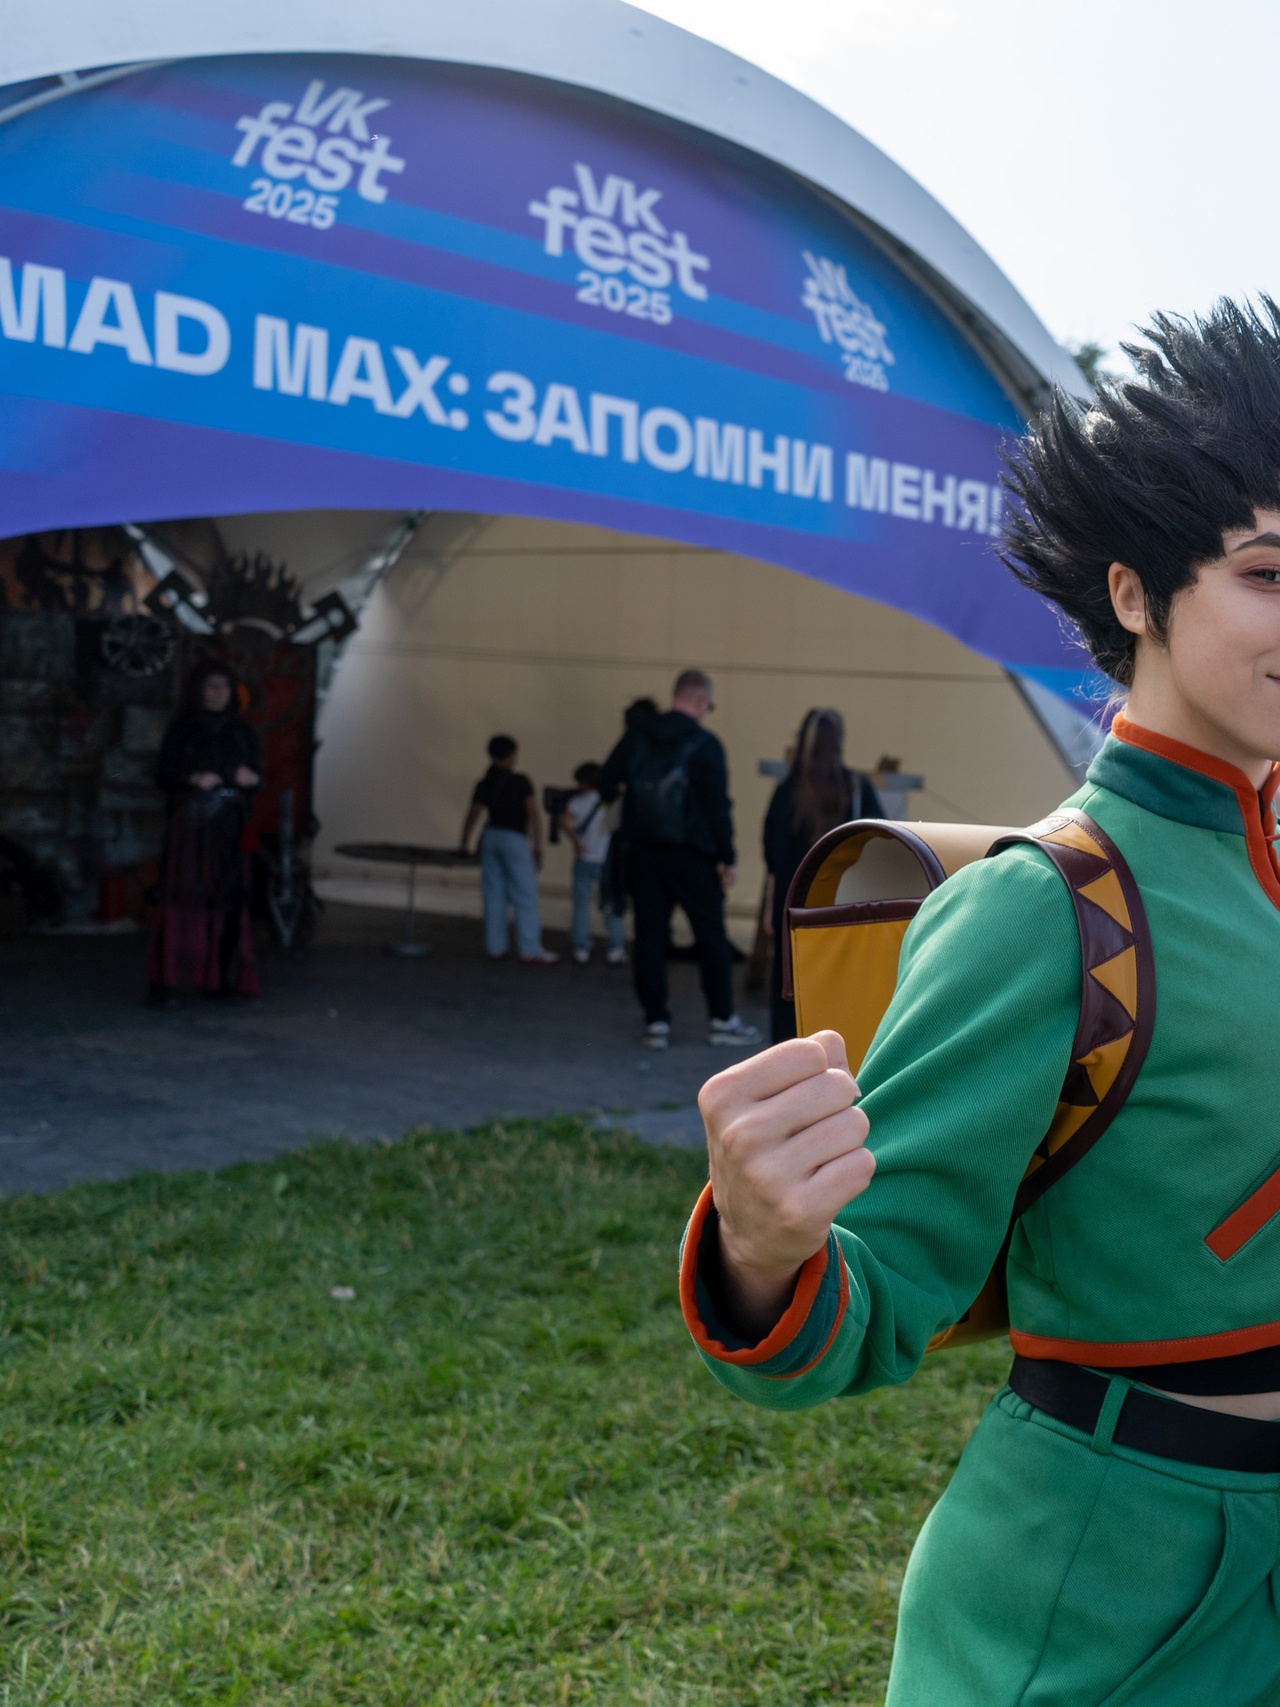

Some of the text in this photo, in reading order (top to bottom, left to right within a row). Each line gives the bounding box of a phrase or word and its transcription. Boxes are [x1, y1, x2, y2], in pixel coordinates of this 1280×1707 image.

[296, 80, 388, 140] VK
[232, 101, 404, 202] fest
[244, 180, 338, 229] 2025
[575, 163, 665, 233] VK
[529, 186, 709, 299] fest
[577, 272, 672, 325] 2025
[0, 256, 230, 375] MAD
[254, 314, 469, 430] MAX:
[485, 371, 833, 501] ЗАПОМНИ
